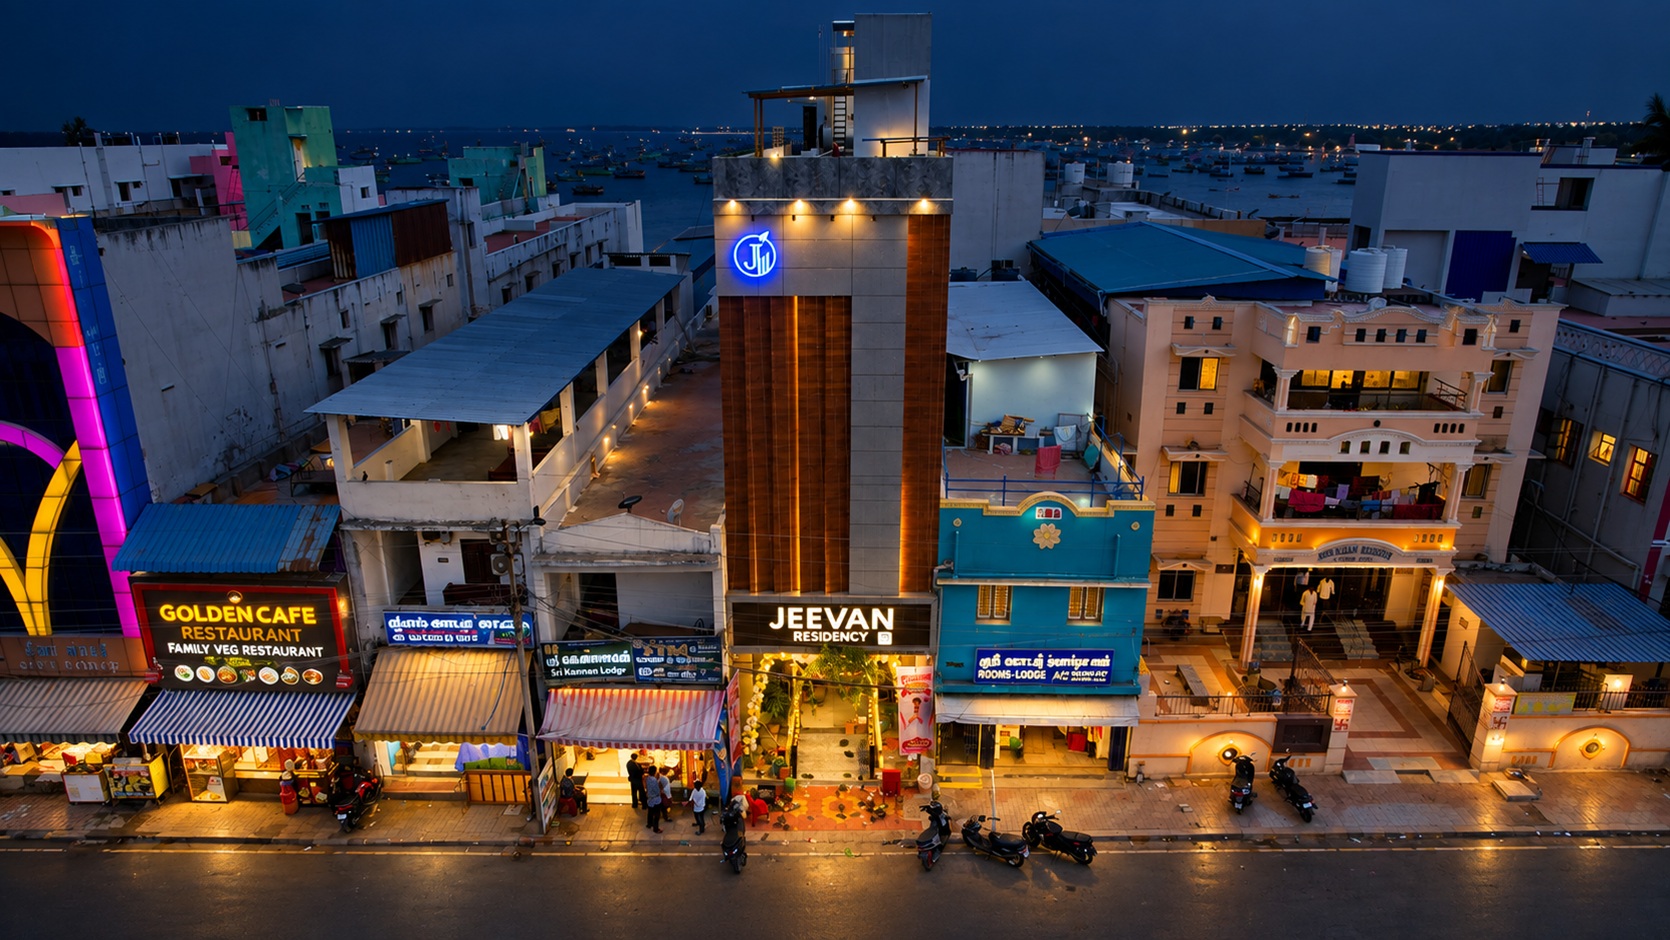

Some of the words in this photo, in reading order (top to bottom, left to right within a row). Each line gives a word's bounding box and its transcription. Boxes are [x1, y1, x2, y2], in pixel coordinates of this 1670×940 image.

[159, 603, 254, 623] GOLDEN
[255, 605, 317, 625] CAFE
[768, 606, 895, 631] JEEVAN
[181, 626, 302, 643] RESTAURANT
[793, 631, 869, 643] RESIDENCY
[167, 642, 210, 655] FAMILY
[213, 644, 239, 656] VEG
[242, 645, 324, 658] RESTAURANT
[551, 668, 563, 677] Sri
